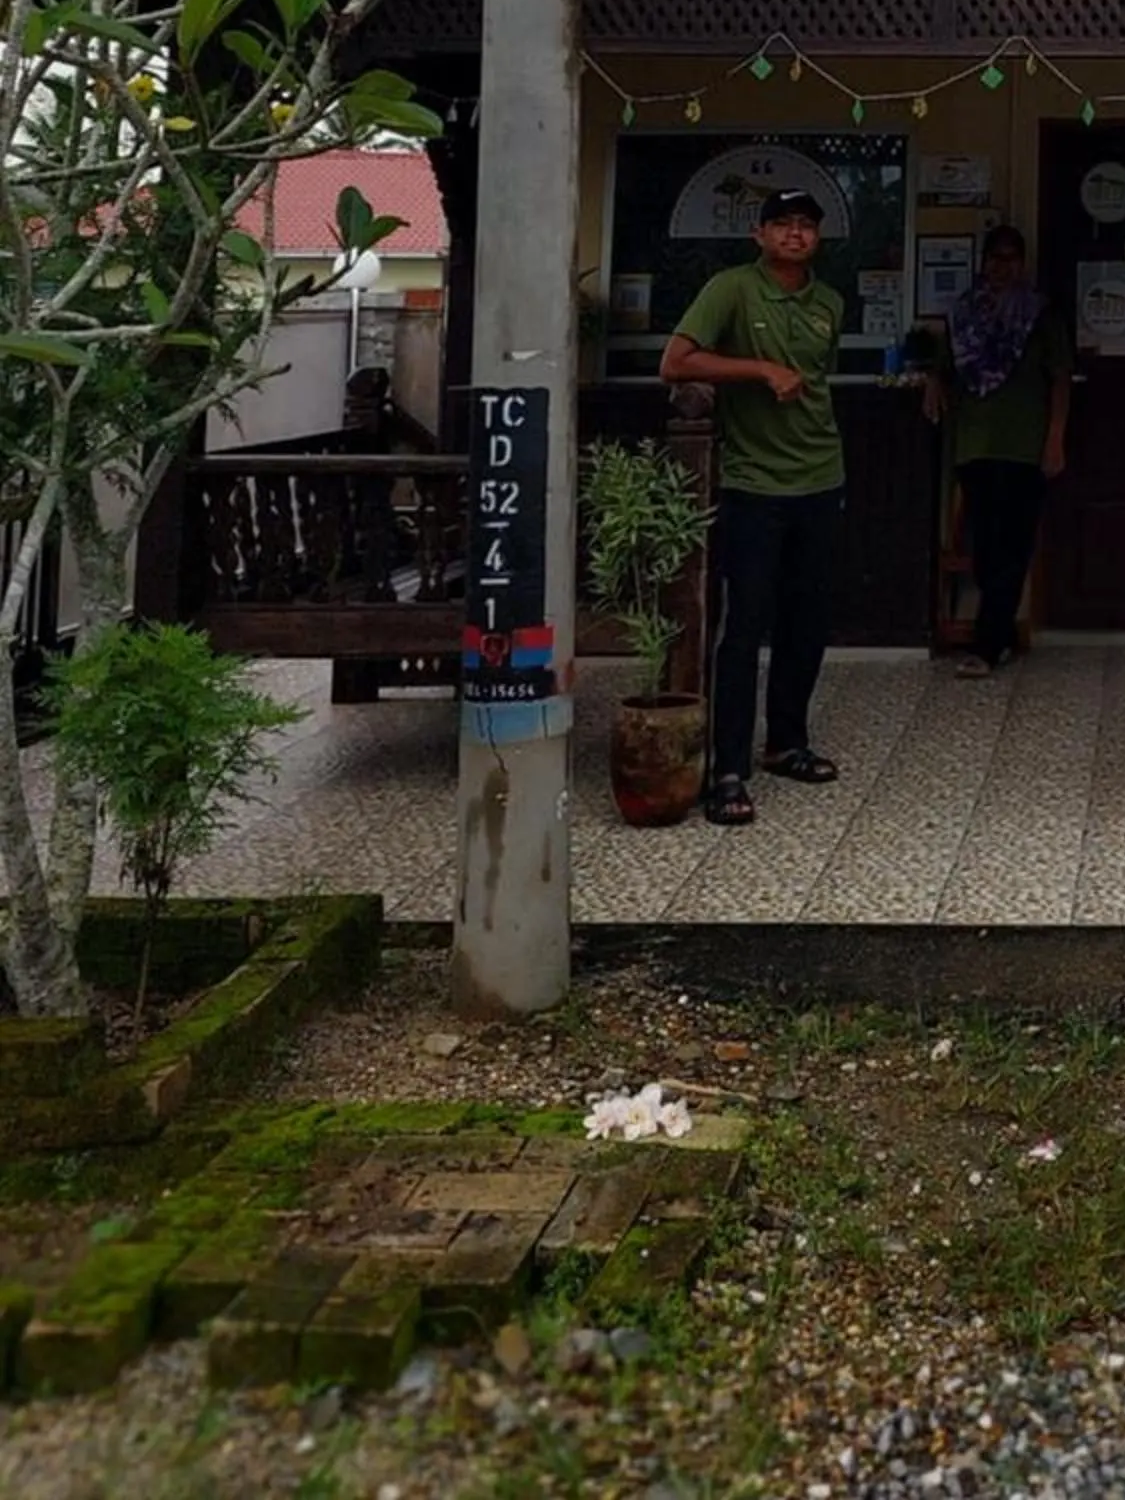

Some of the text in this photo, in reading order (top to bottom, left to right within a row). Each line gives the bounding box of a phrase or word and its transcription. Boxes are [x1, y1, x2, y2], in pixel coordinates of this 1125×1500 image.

[479, 395, 526, 429] TC
[489, 435, 513, 467] D
[479, 480, 520, 515] 52
[484, 538, 504, 572] 4
[484, 597, 496, 630] 1
